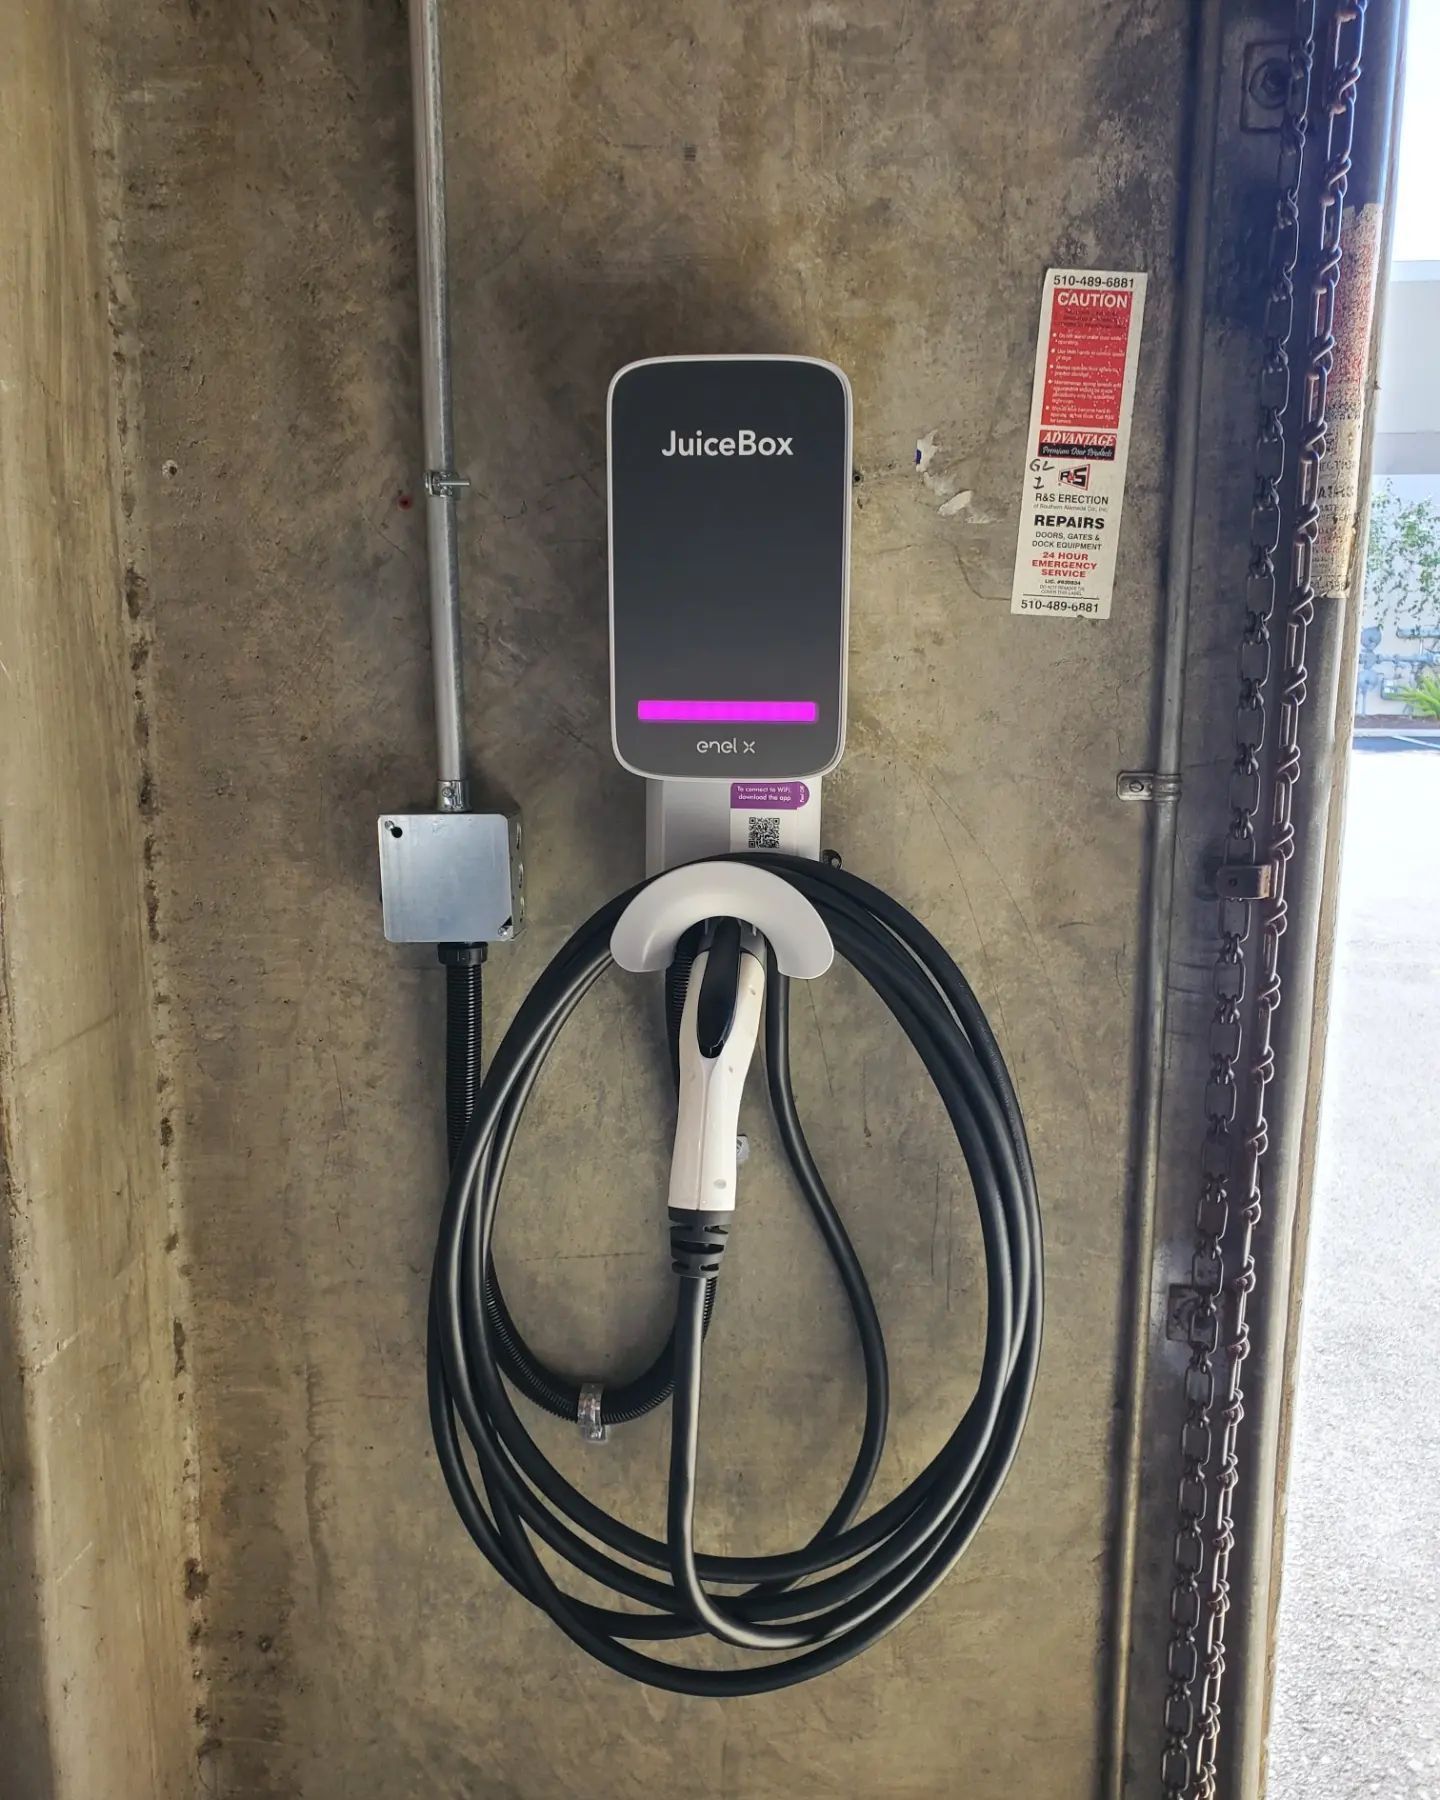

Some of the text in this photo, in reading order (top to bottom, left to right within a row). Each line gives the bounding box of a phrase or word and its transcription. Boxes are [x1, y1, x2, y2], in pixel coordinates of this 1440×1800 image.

[1053, 275, 1134, 288] 510-489-6881
[1057, 291, 1128, 308] CAUTION
[661, 429, 794, 456] JuiceBox
[1042, 431, 1116, 446] ADVANTAGE
[1042, 446, 1112, 457] Premium Door Products
[1035, 492, 1109, 505] R&S ERECTION
[1034, 514, 1105, 529] REPAIRS
[1035, 531, 1066, 540] DOORS,
[1067, 533, 1093, 541] GATES
[1032, 540, 1102, 550] DOCK EQUIPMENT
[1042, 551, 1089, 560] 24 HOUR
[1032, 559, 1098, 570] EMERGENCY
[1041, 569, 1086, 578] SERVICE
[1020, 599, 1099, 613] 510-489-6881
[696, 737, 738, 754] enel
[738, 793, 767, 801] download
